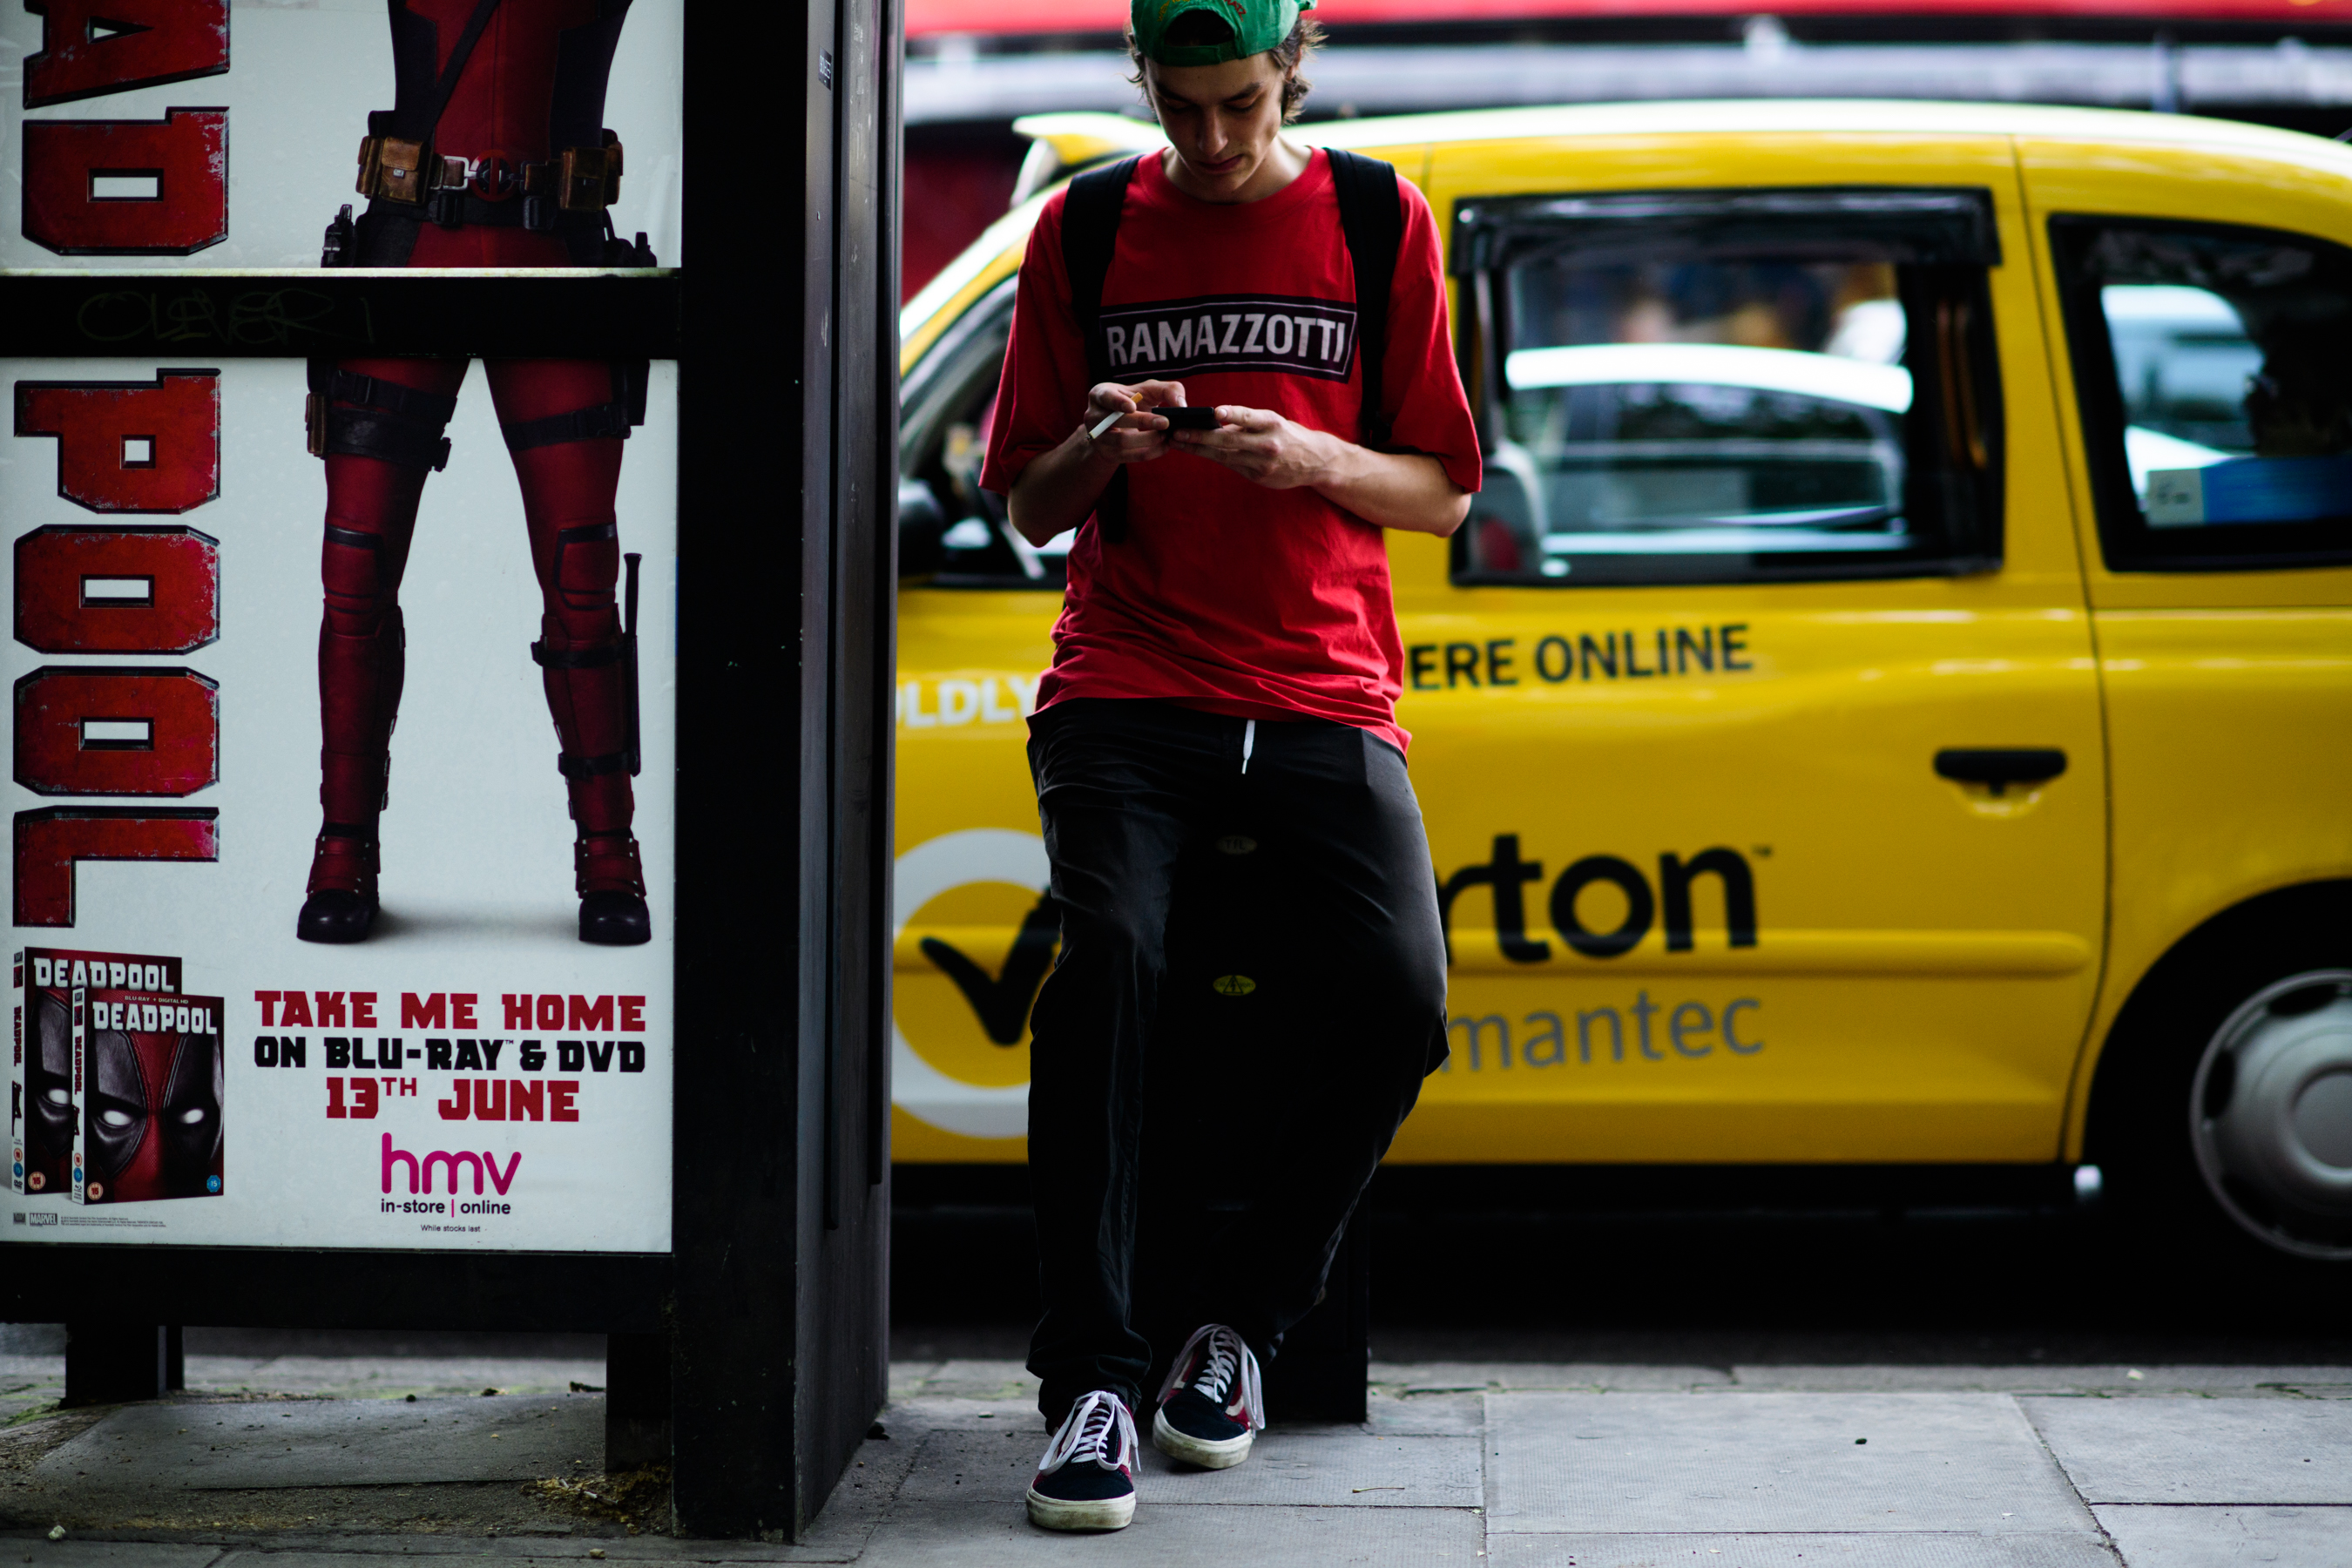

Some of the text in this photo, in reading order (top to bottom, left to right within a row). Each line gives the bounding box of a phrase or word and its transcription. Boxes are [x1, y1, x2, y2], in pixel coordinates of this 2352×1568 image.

[1106, 314, 1346, 367] RAMAZZOTTI
[1409, 624, 1754, 691] ERE ONLINE
[896, 676, 1040, 728] LDLY
[33, 956, 174, 993] DEADPOOL
[92, 1000, 218, 1035] DEADPOOL
[254, 990, 646, 1032] TAKE ME HOME
[13, 1005, 22, 1067] DEADPOOL
[254, 1036, 306, 1068] ON
[519, 1039, 547, 1071] &
[557, 1040, 645, 1073] DVD
[74, 1035, 83, 1096] DEADPOOL
[438, 1078, 579, 1122] JUNE
[382, 1132, 522, 1196] hmv
[30, 1213, 57, 1225] MARVEL
[381, 1198, 511, 1214] in-store online
